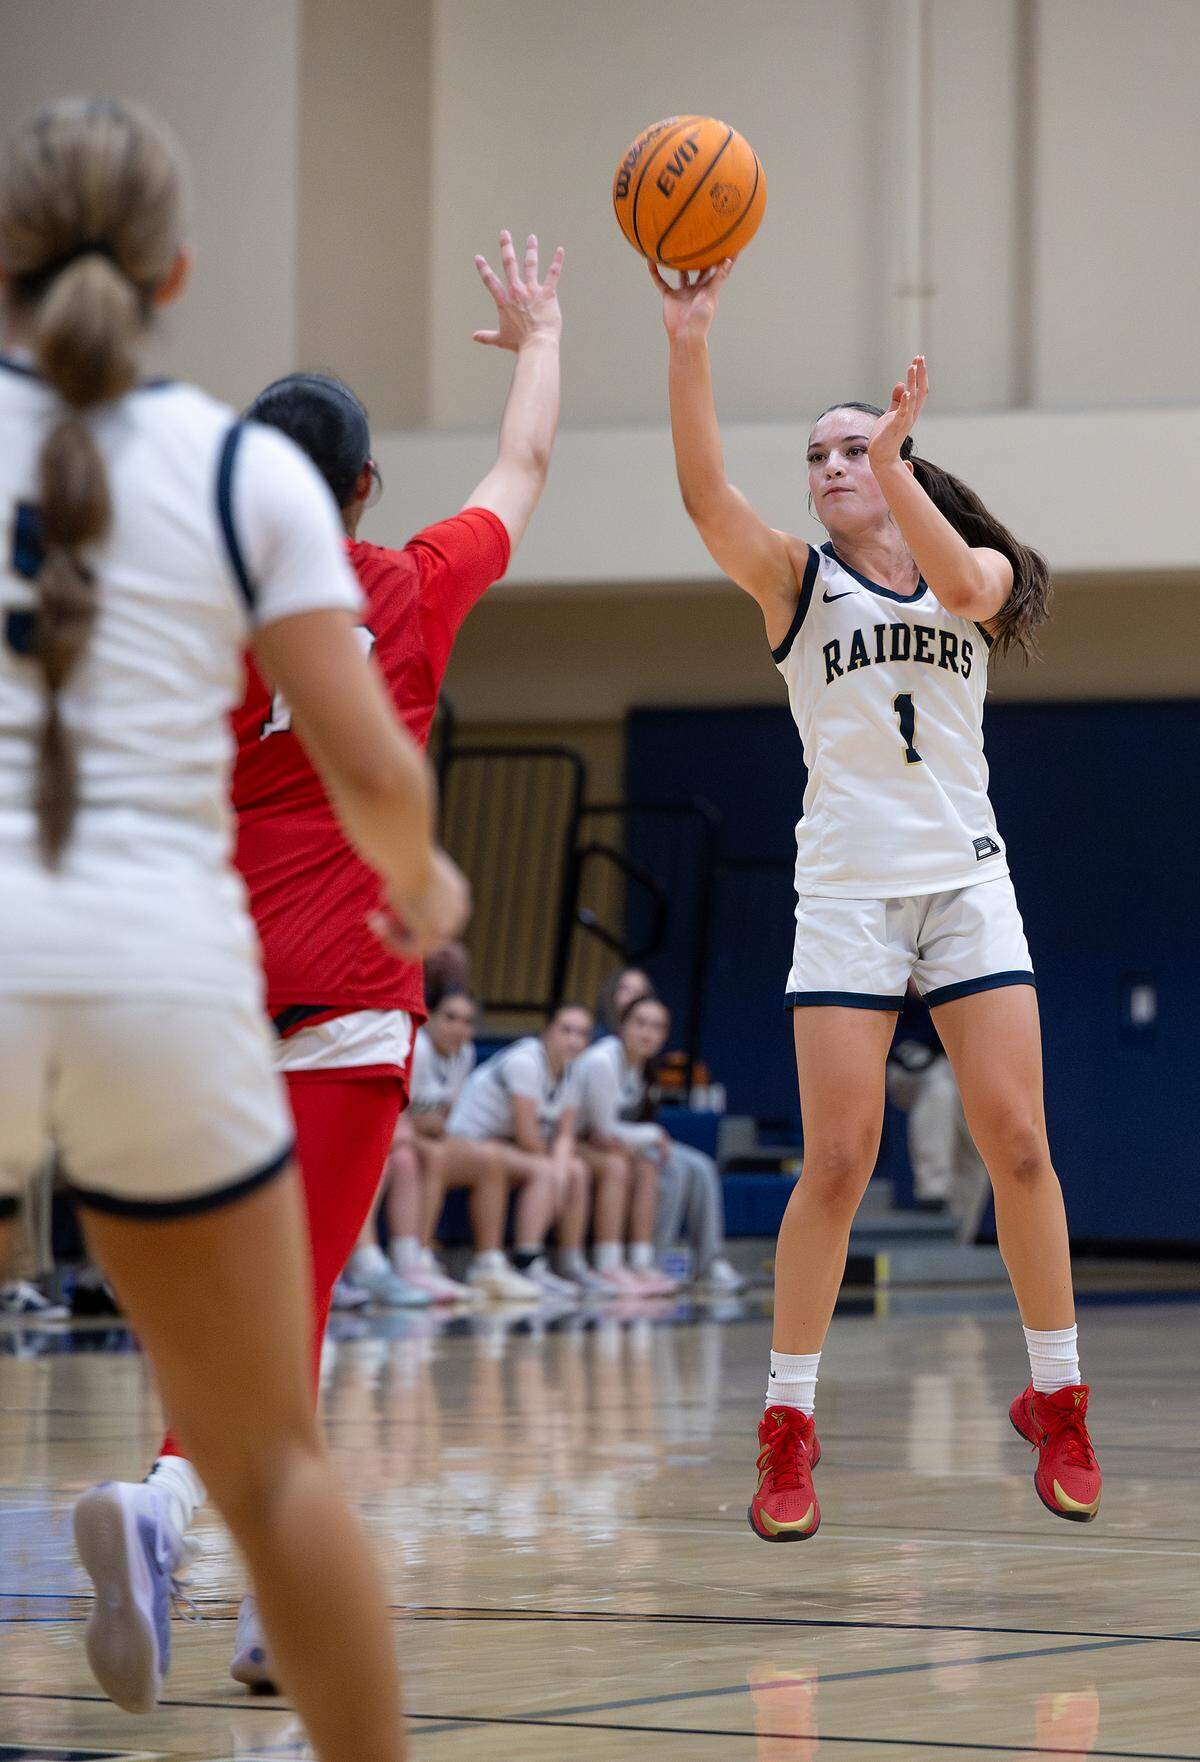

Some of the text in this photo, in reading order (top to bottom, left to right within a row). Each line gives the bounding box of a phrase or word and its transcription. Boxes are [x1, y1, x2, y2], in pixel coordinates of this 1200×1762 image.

[656, 139, 699, 198] EVO
[822, 622, 974, 685] RAIDERS
[892, 692, 923, 764] 1
